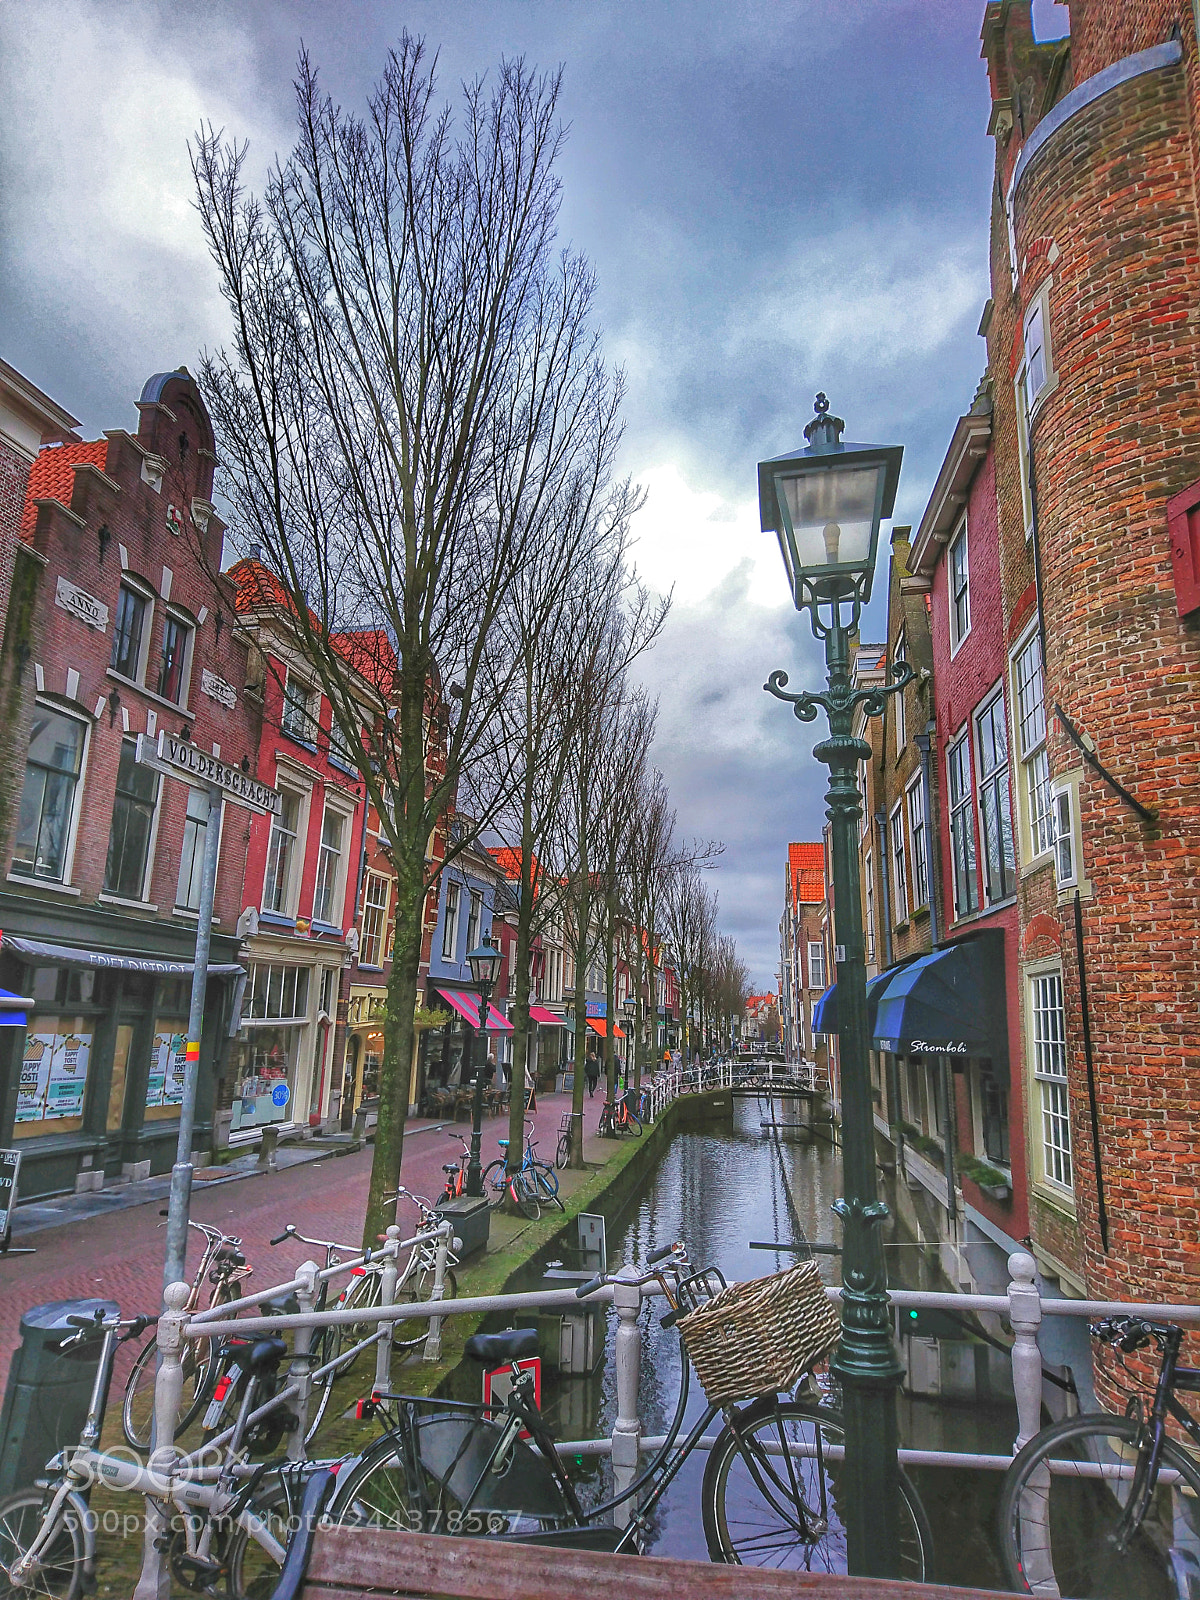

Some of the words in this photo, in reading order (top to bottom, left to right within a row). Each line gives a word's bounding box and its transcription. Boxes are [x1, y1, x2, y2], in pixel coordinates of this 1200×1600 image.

[70, 594, 100, 618] ANNO
[910, 1040, 967, 1054] Stromboli
[20, 1072, 39, 1082] OSTI
